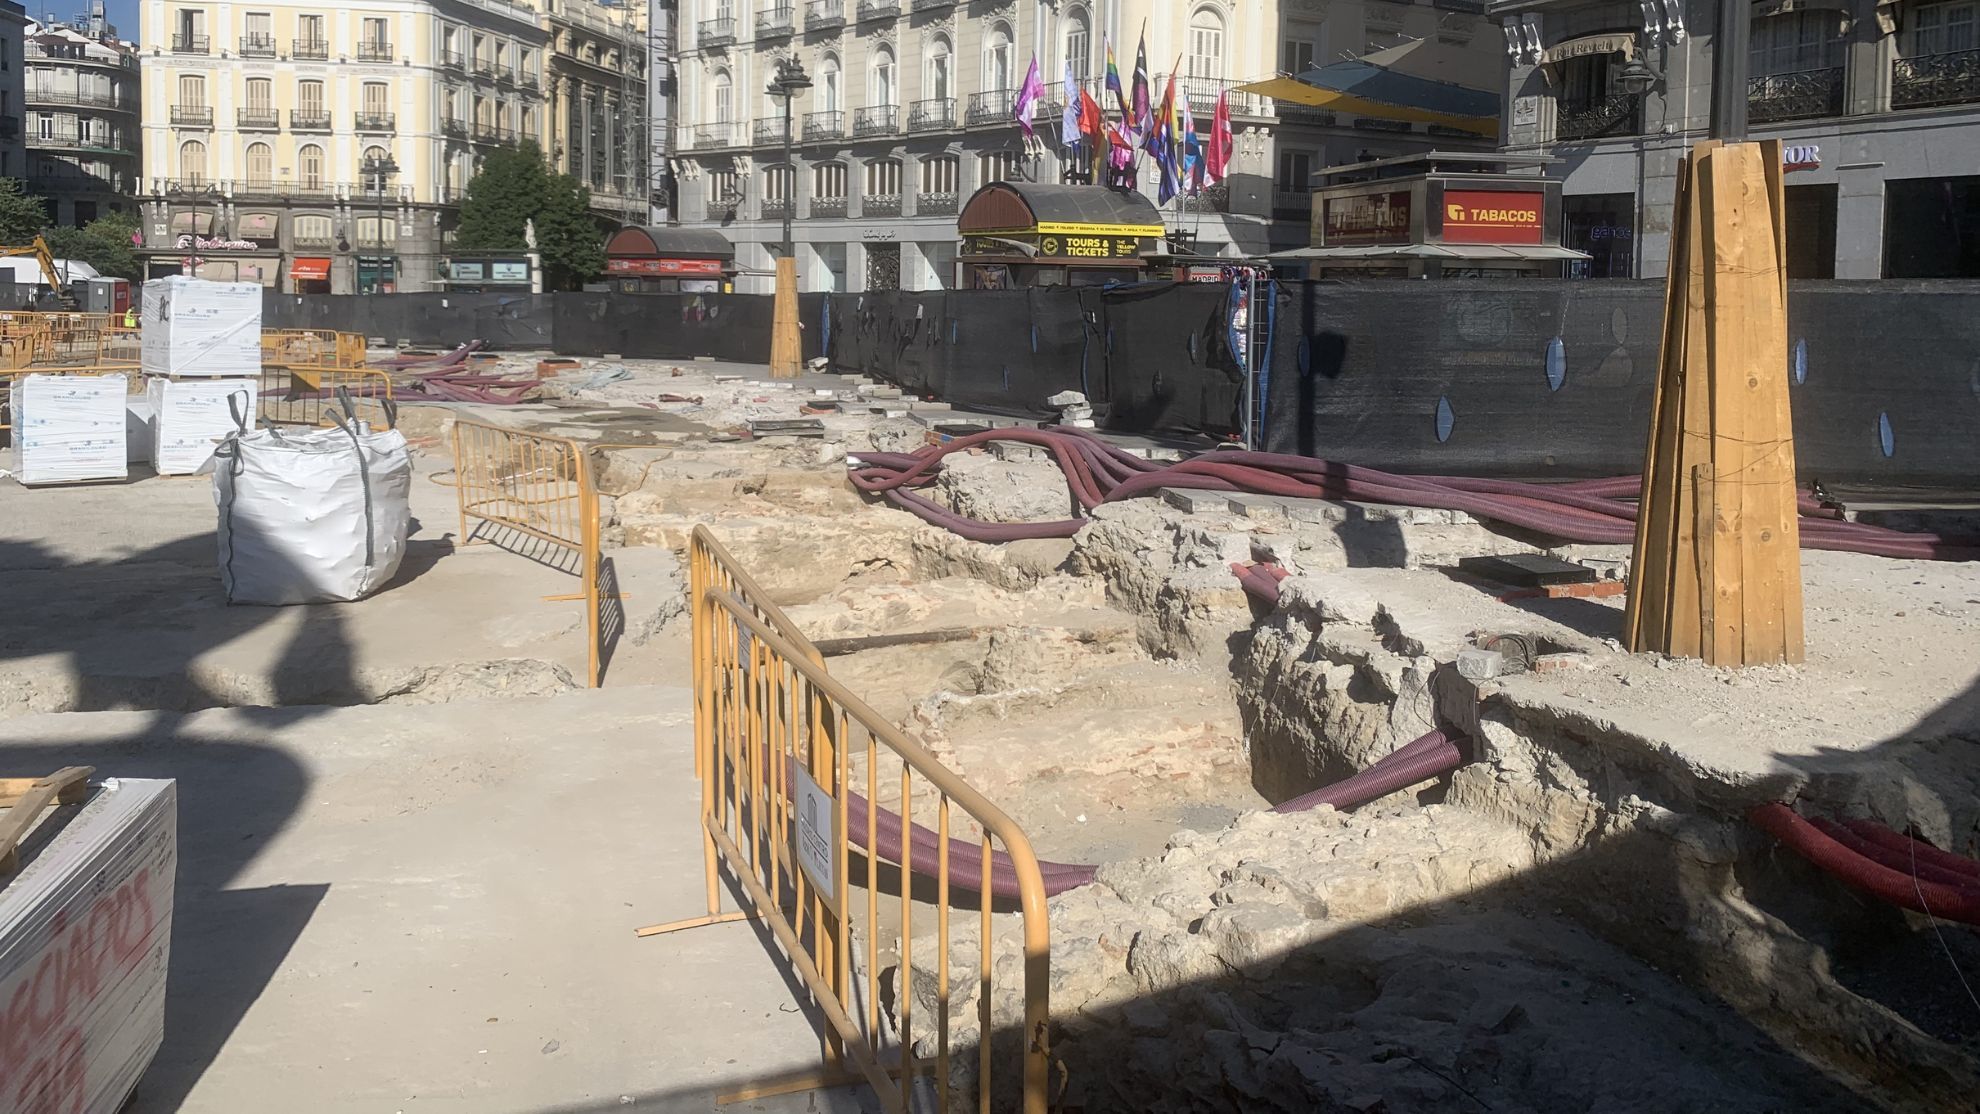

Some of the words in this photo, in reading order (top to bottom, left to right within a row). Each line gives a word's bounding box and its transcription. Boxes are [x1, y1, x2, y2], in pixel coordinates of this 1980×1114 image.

[1471, 209, 1536, 222] TABACOS
[1066, 238, 1100, 247] TOURS
[1102, 239, 1109, 248] &
[1066, 247, 1109, 257] TICKETS
